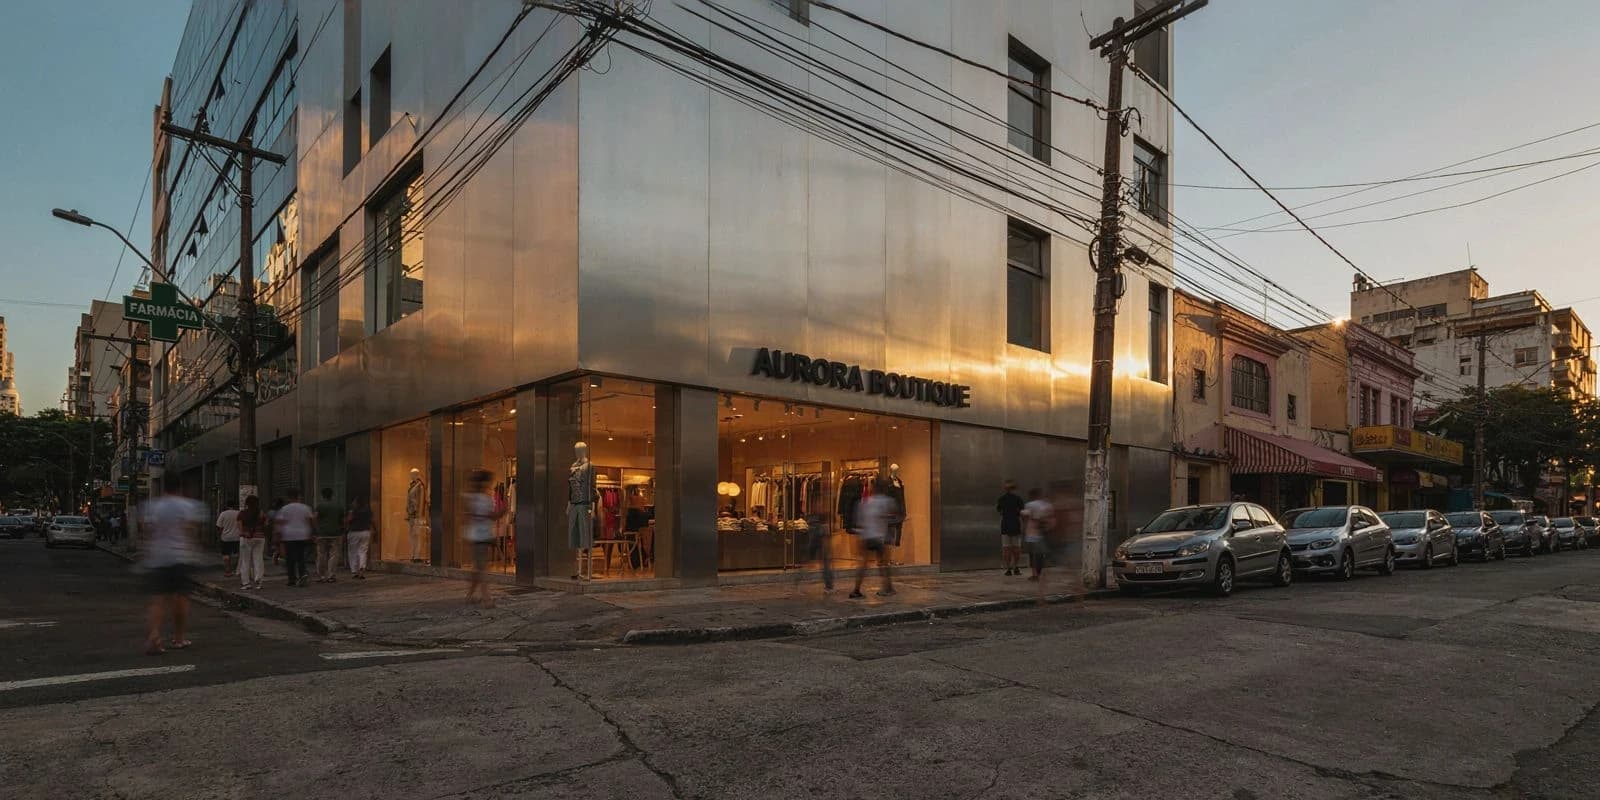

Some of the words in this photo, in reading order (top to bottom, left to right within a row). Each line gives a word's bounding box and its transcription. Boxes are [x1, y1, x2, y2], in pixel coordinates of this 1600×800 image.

[129, 303, 198, 322] FARMÁCIA
[752, 347, 864, 392] AURORA
[867, 369, 971, 408] BOUTIQUE
